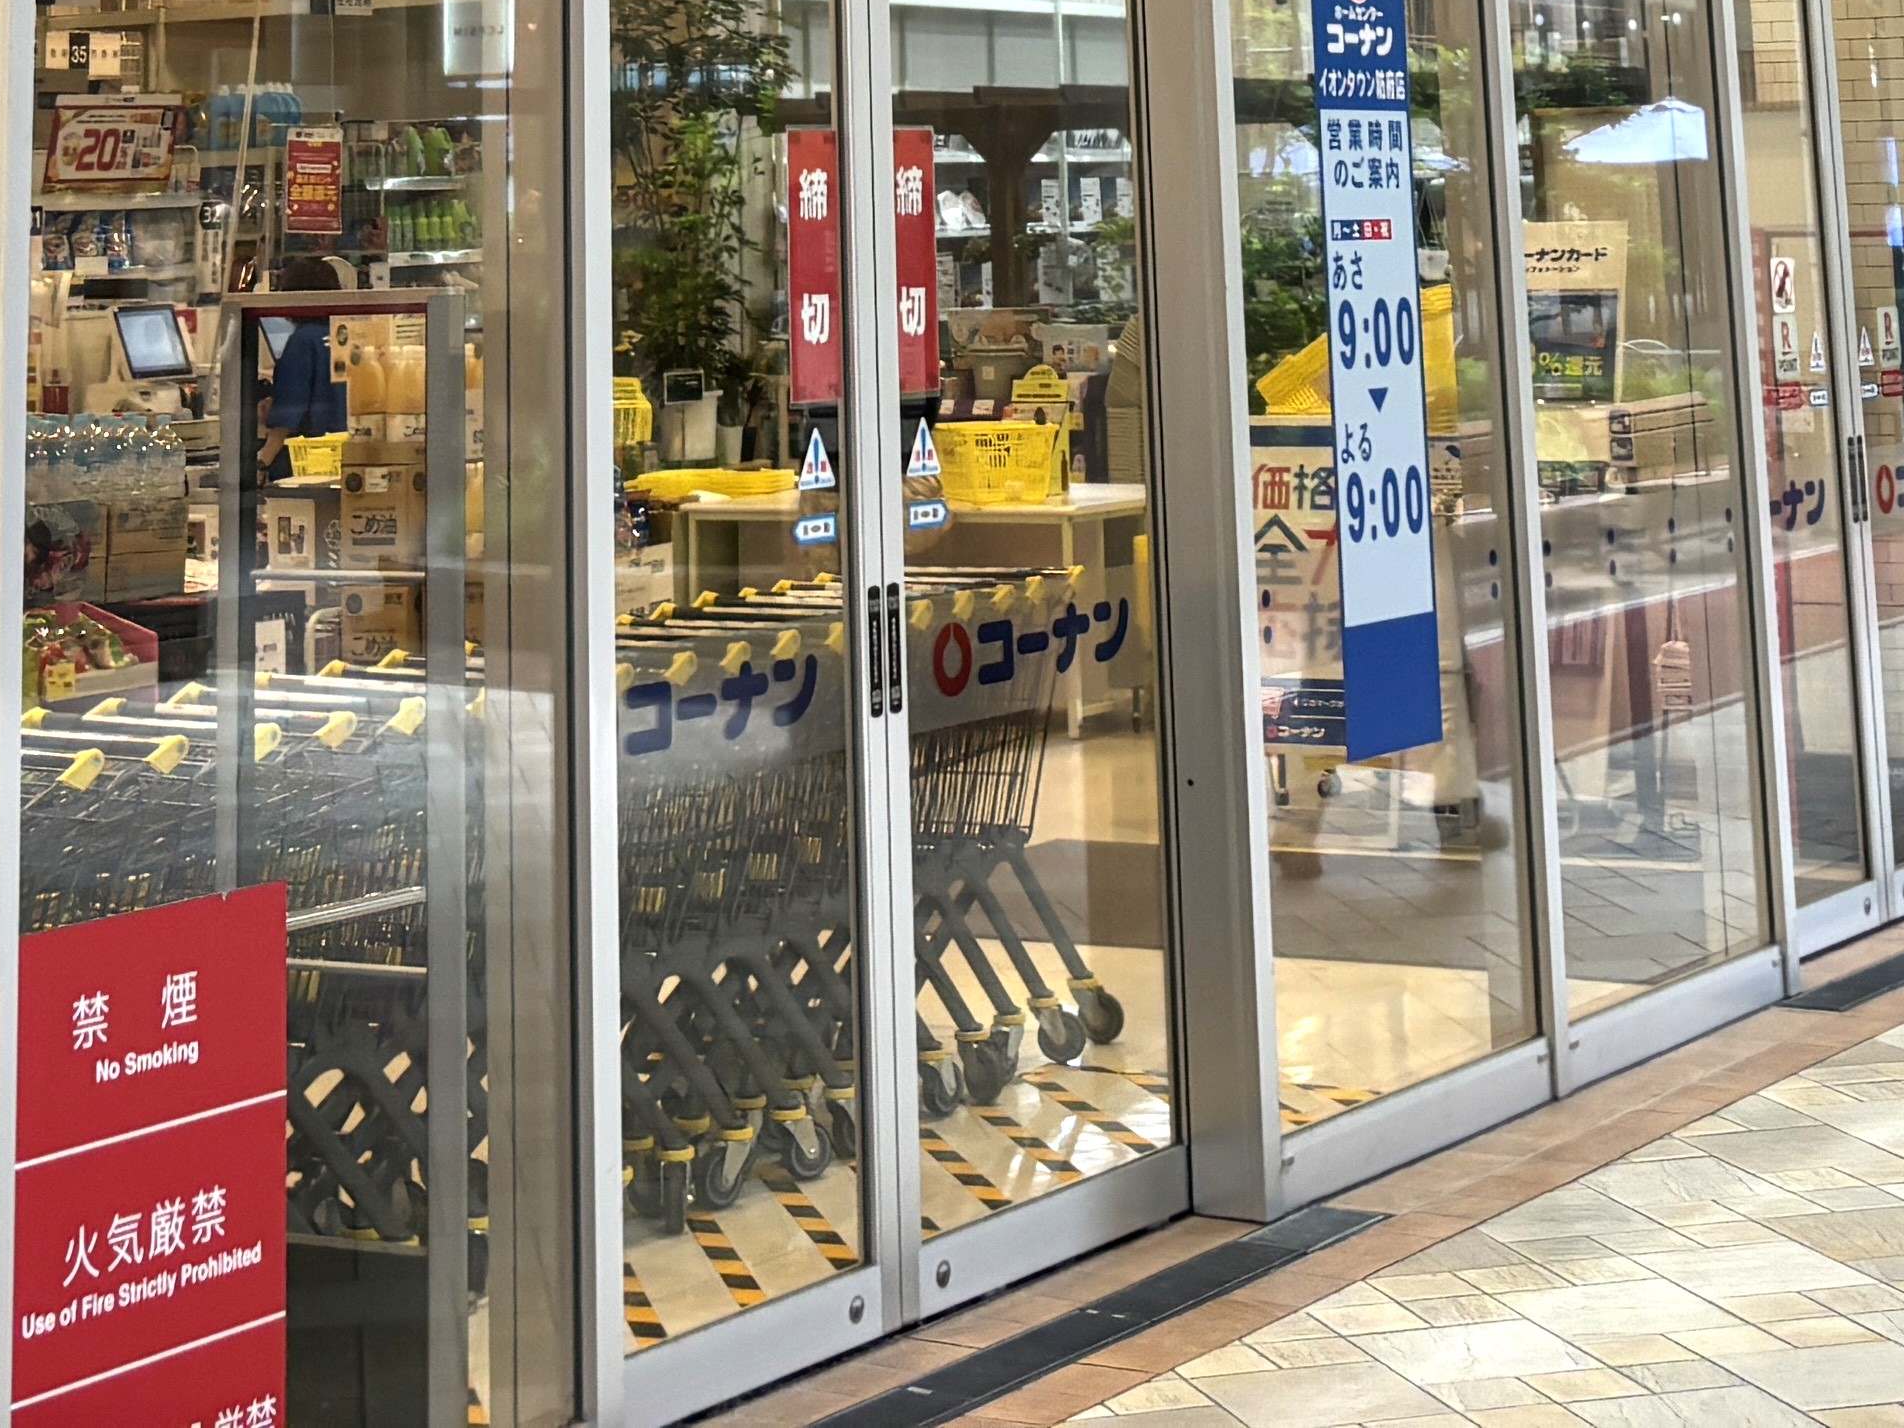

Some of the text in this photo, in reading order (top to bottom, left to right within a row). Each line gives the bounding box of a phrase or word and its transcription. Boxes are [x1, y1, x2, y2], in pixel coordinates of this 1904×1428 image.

[70, 45, 87, 63] 35
[1326, 23, 1393, 56] コーナン
[75, 128, 122, 172] 20
[1327, 119, 1403, 153] 営業時間
[1334, 157, 1400, 190] のご案内
[201, 206, 222, 224] 32
[799, 168, 830, 345] 締切
[1332, 250, 1364, 292] あさ
[1524, 247, 1607, 263] ーナンカード
[1338, 297, 1415, 370] 9:00
[1340, 423, 1372, 464] よる
[1346, 464, 1424, 543] 9:00
[1770, 478, 1826, 532] ーナン
[978, 597, 1129, 685] コーナン
[625, 653, 818, 756] コーナン
[96, 1040, 199, 1084] No Smoking
[63, 1185, 227, 1288] 火気厳禁
[22, 1240, 262, 1339] Use of Fire Strictly Prohibited
